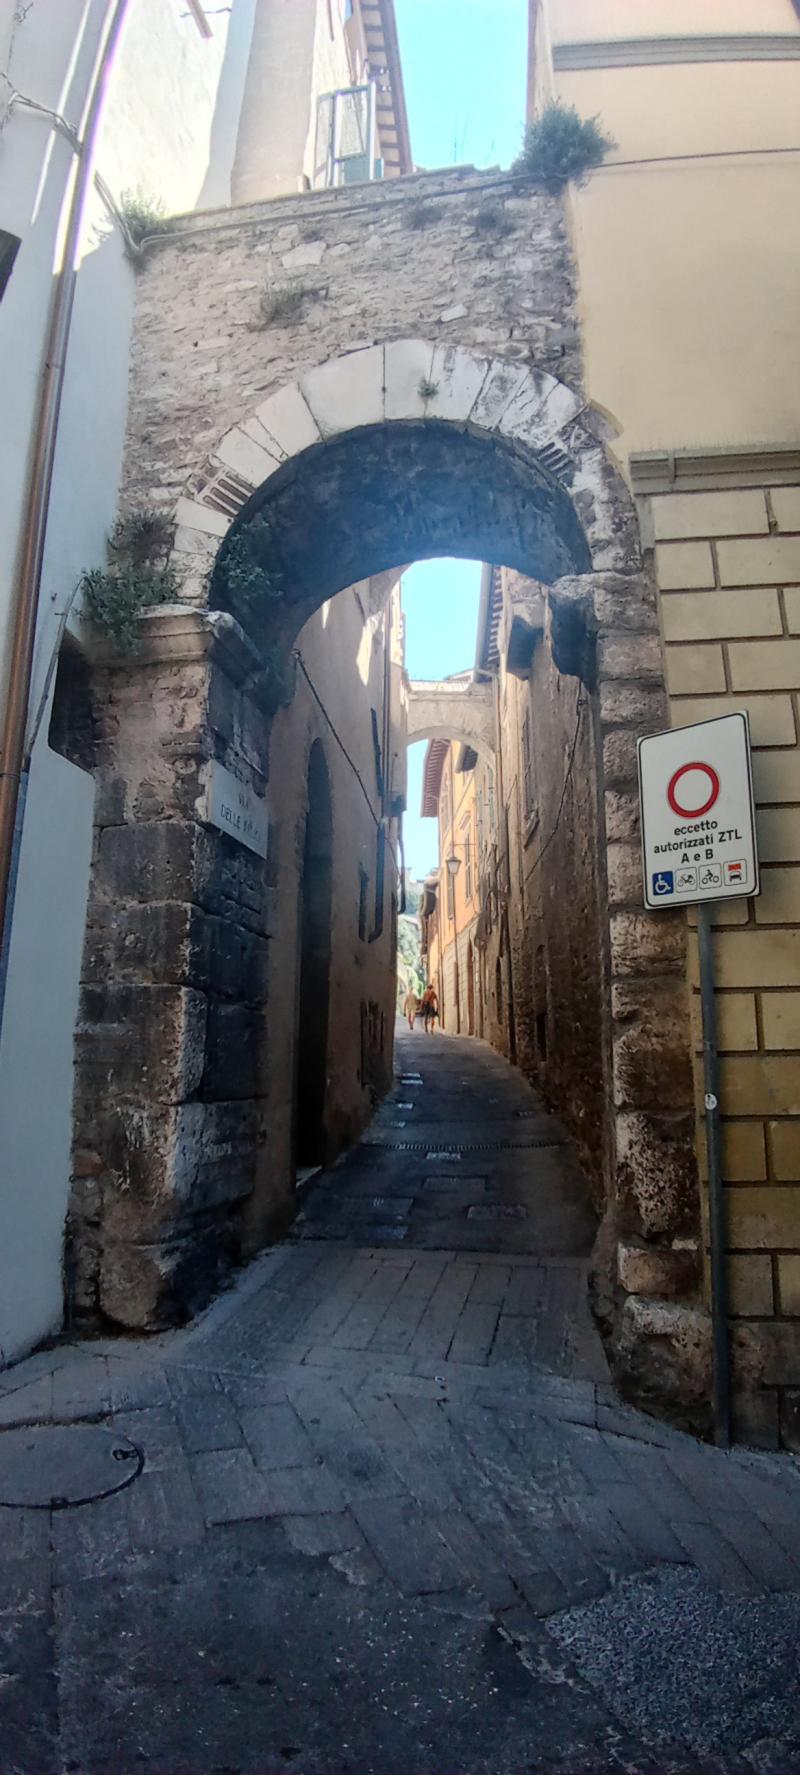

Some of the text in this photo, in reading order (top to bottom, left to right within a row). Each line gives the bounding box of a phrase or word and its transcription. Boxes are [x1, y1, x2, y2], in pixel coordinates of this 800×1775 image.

[674, 819, 718, 835] eccetto
[654, 829, 742, 854] autorizzati ZTL
[681, 849, 714, 864] A e B
